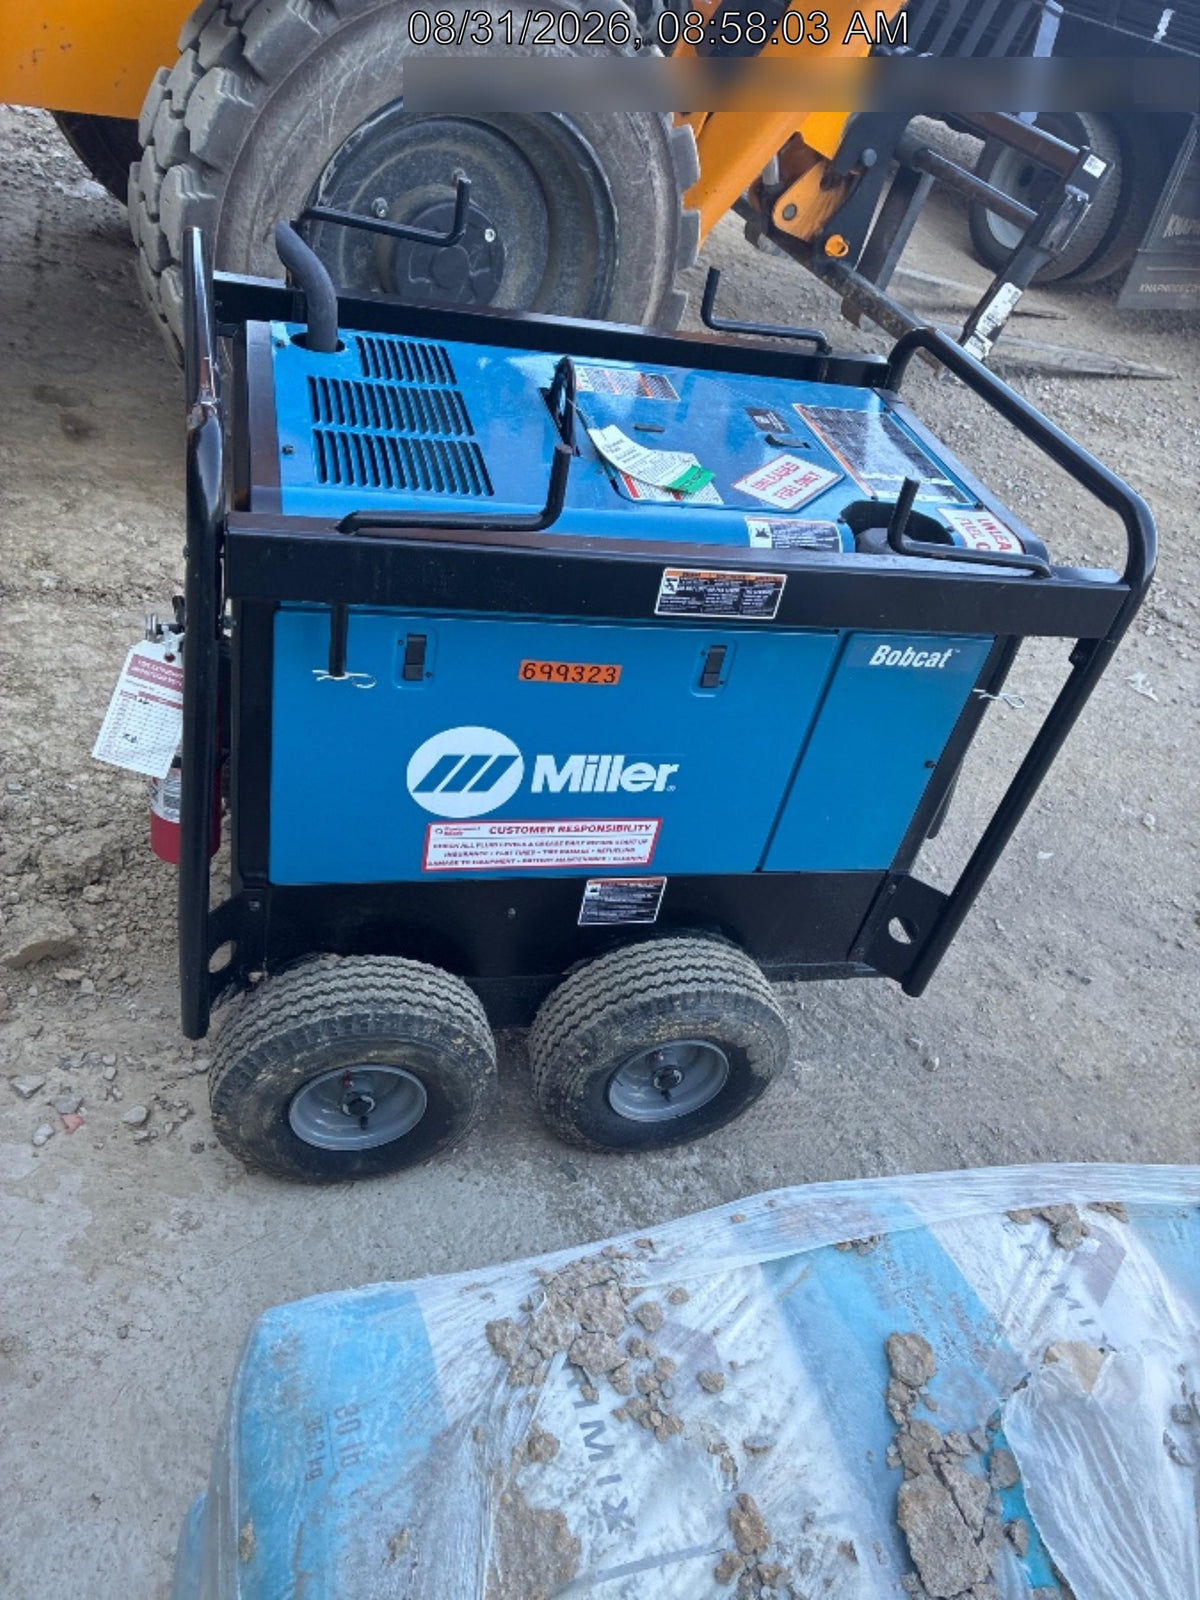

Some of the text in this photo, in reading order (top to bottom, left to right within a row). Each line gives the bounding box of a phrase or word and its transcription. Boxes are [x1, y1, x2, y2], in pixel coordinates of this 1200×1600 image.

[868, 644, 955, 669] Bobcat
[522, 661, 618, 685] 699323
[530, 754, 680, 794] Miller
[489, 825, 556, 835] CUSTOMER
[557, 823, 652, 834] RESPONSIBILITY
